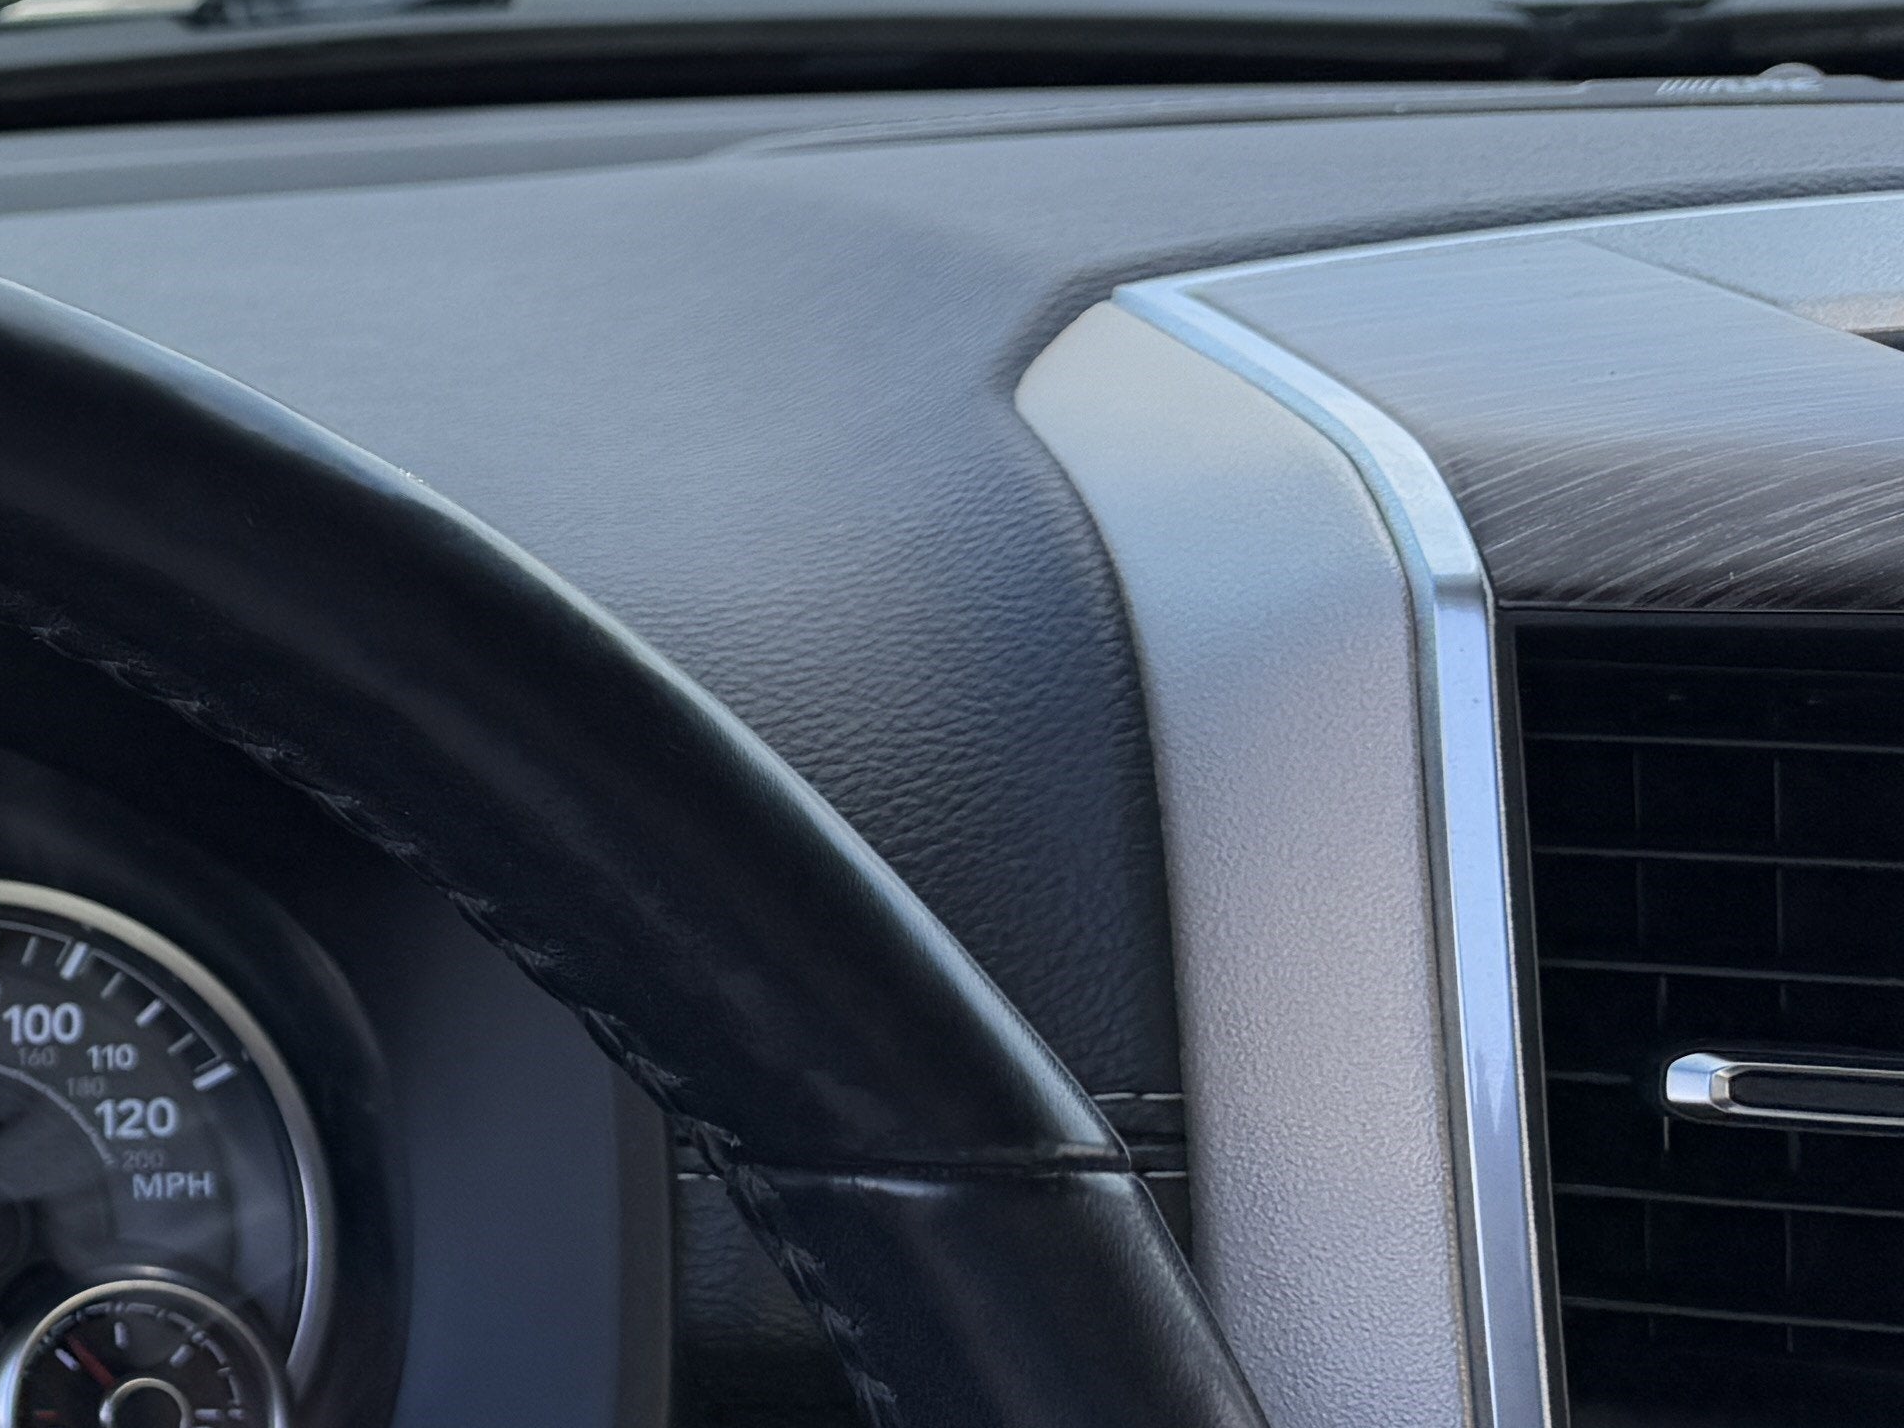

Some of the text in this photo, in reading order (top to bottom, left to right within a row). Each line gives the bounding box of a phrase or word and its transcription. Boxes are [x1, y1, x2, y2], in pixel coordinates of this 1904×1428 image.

[2, 1002, 84, 1045] 100
[86, 1043, 139, 1071] 110
[93, 1095, 181, 1141] 120
[131, 1171, 215, 1201] MPH
